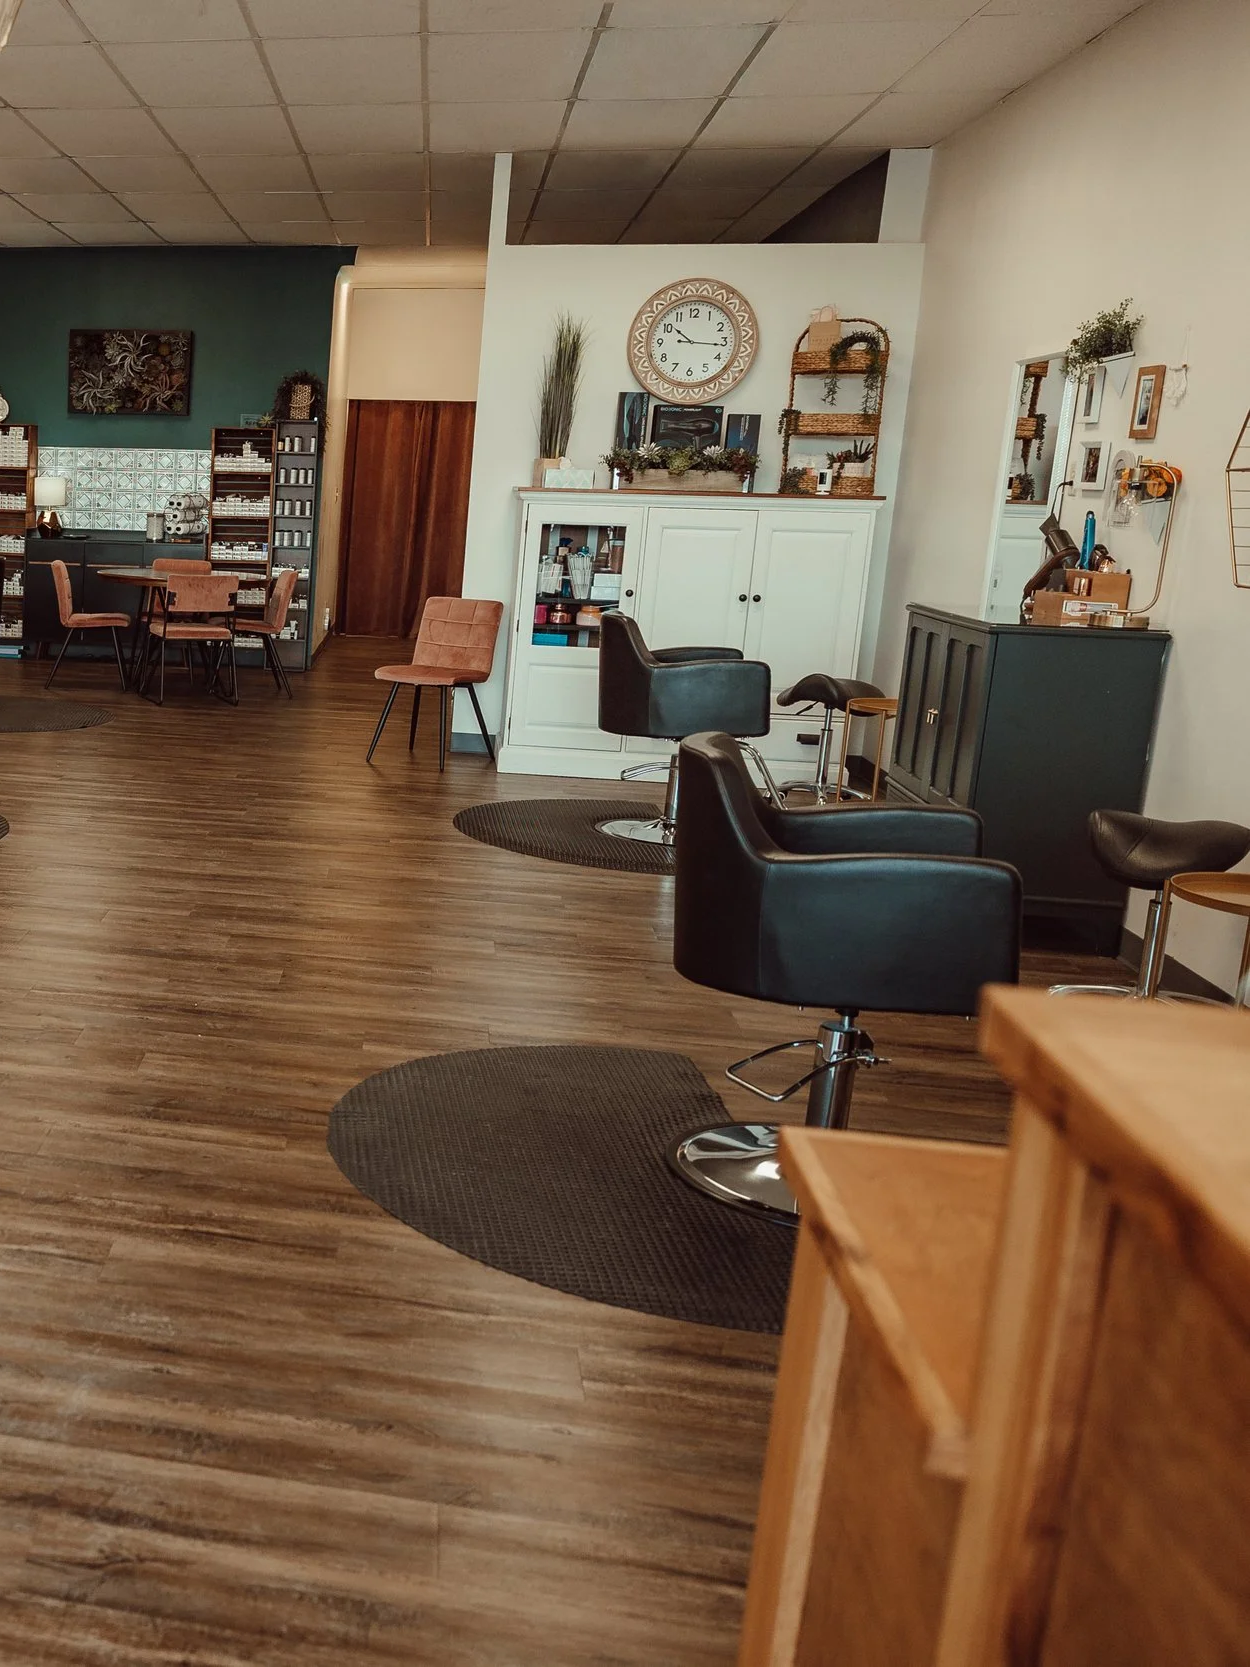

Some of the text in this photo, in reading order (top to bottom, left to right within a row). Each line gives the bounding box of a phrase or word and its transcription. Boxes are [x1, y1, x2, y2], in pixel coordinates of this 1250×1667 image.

[675, 312, 683, 323] 11
[689, 308, 700, 319] 12
[708, 311, 712, 321] 1
[663, 323, 673, 334] 10
[716, 322, 725, 332] 2
[656, 338, 664, 348] 9
[720, 336, 728, 347] 3
[660, 353, 668, 363] 8
[713, 352, 722, 361] 4
[671, 362, 679, 372] 7
[685, 367, 693, 377] 6
[701, 363, 709, 373] 5
